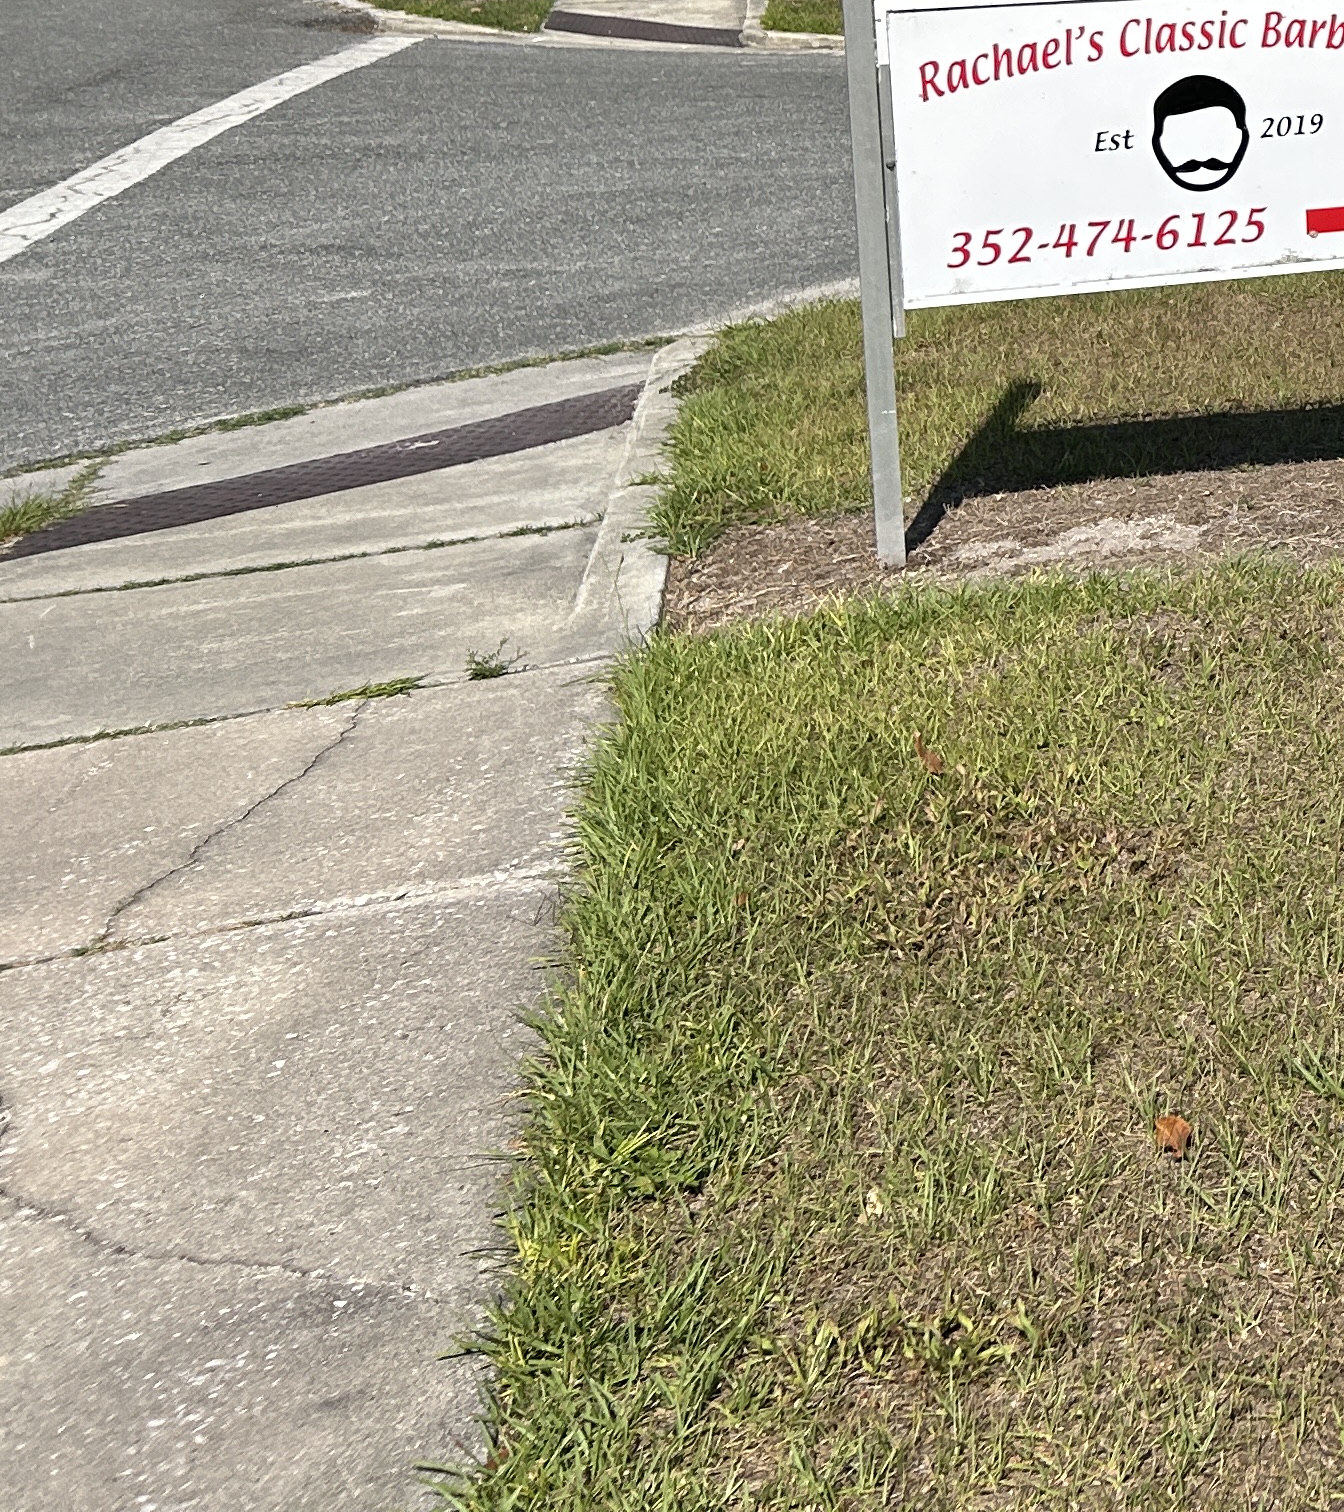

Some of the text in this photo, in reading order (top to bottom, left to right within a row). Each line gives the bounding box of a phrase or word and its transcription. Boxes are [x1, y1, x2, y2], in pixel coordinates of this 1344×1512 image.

[917, 26, 1105, 102] Rachael's
[1119, 9, 1247, 59] Classic
[1095, 112, 1325, 153] Est 2019
[946, 205, 1269, 269] 352-474-6125
